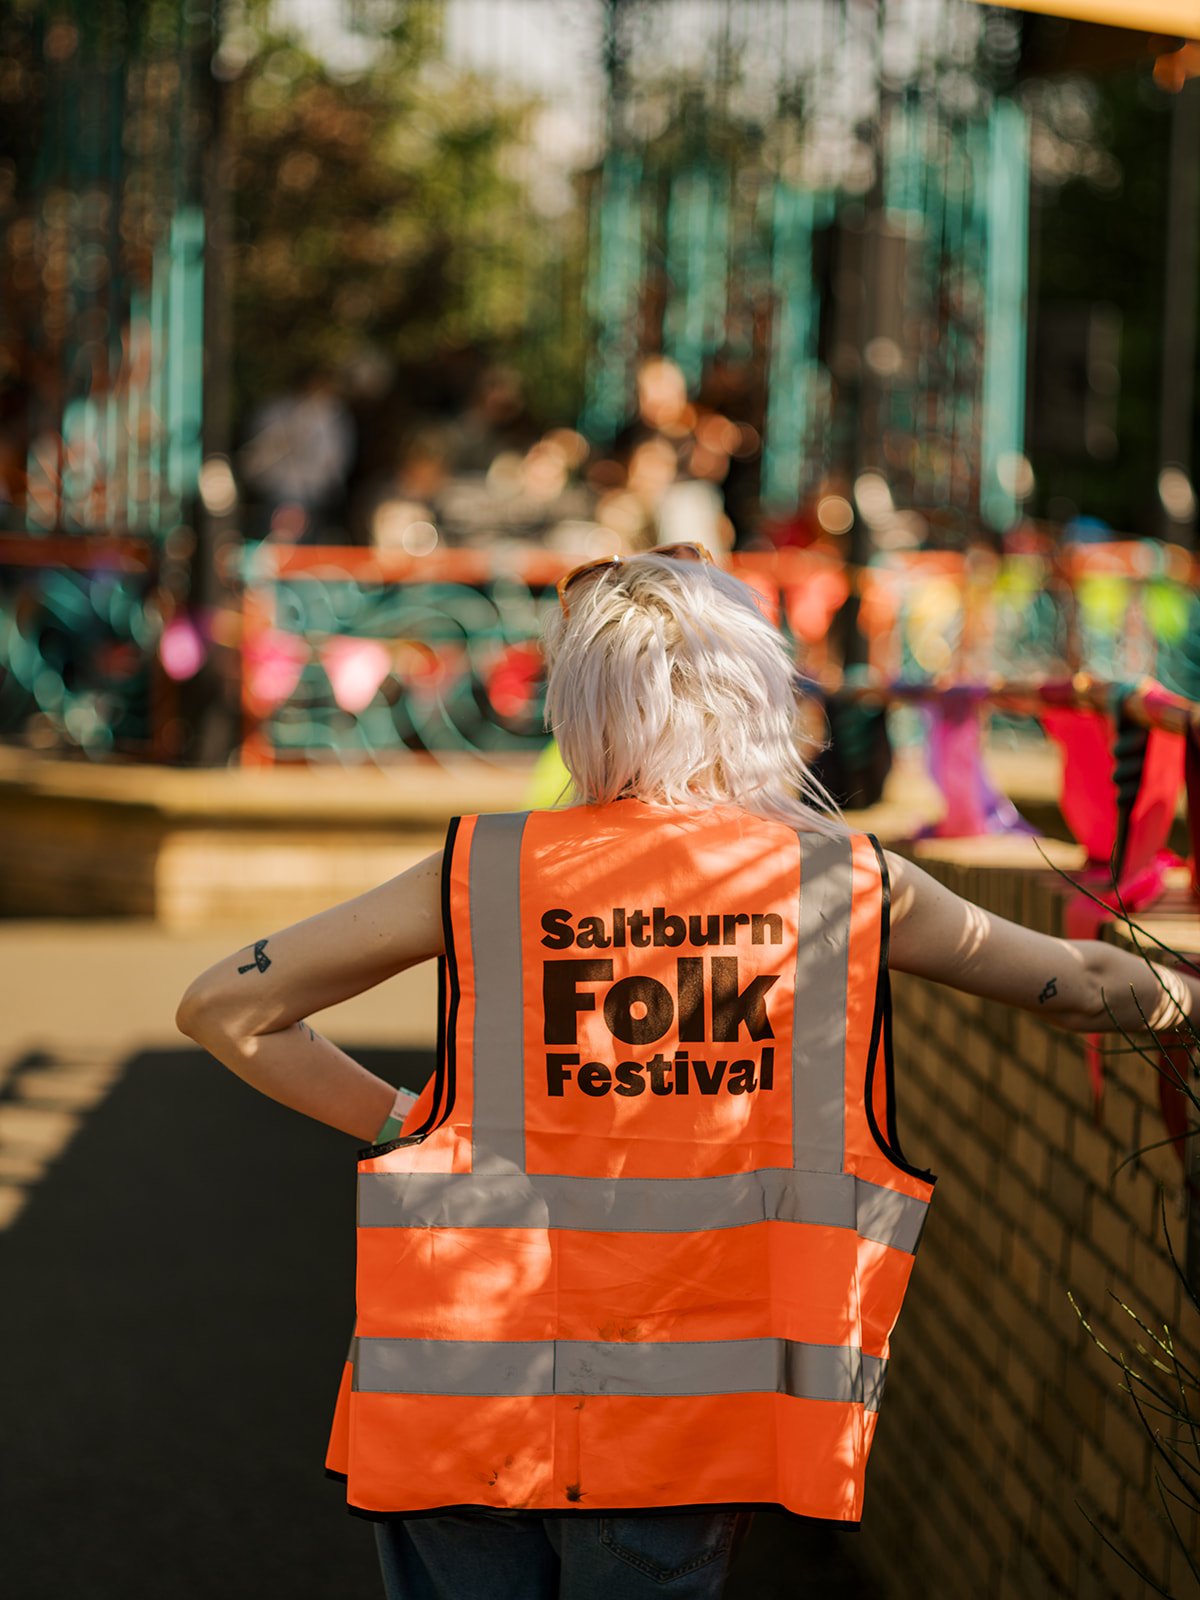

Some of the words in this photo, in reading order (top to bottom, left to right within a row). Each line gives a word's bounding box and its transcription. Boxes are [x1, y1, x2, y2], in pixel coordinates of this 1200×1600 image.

[541, 907, 783, 950] Saltburn
[543, 956, 781, 1045] Folk
[546, 1047, 775, 1097] Festival
